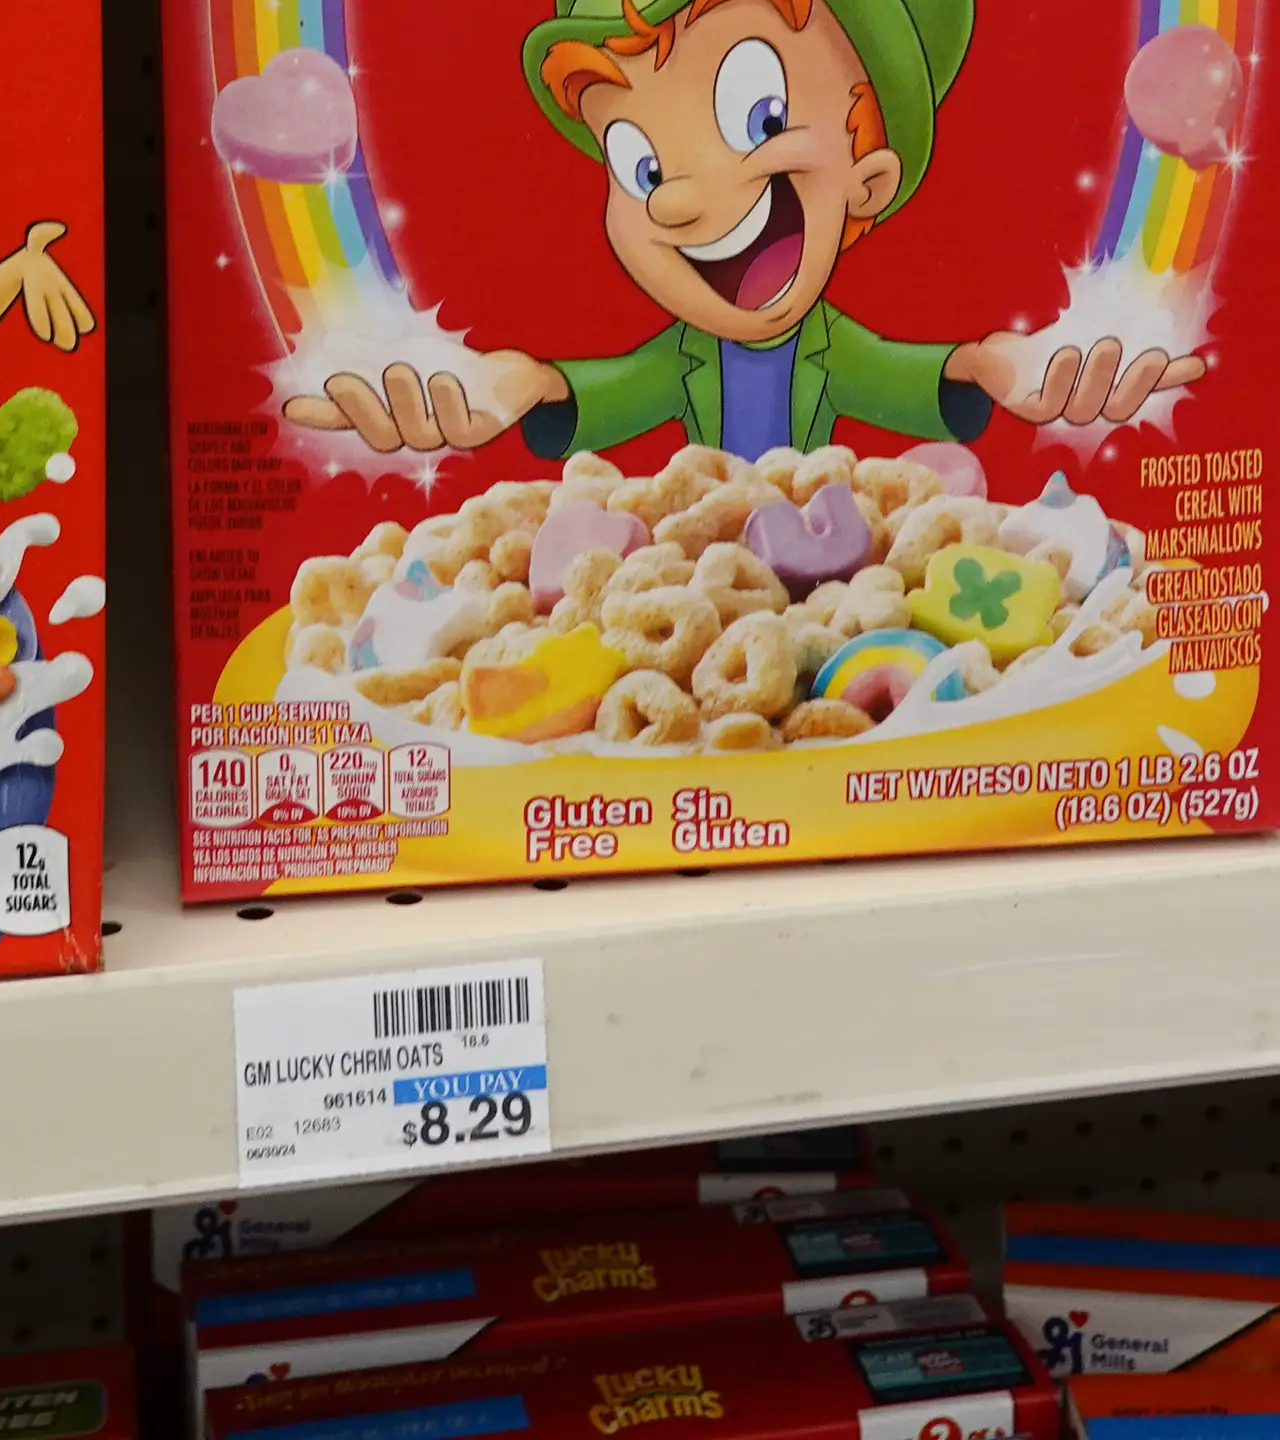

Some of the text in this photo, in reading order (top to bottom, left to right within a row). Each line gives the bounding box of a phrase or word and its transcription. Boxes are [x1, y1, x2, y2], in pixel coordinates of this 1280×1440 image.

[1141, 448, 1262, 488] FROSTED TOASTED
[1175, 484, 1262, 521] CEREAL WITH
[1147, 520, 1262, 560] MARSHMALLOWS
[1147, 563, 1261, 603] CEREAL TOSTADO
[1158, 598, 1261, 638] GLASEADO CON
[1171, 634, 1261, 673] MALVAVISCOS
[847, 748, 1259, 803] NET WT/PESO NETO 1 LB 2.6 OZ
[525, 794, 652, 833] Gluten
[673, 790, 730, 822] Sin
[1055, 787, 1259, 831] (18.6 OZ) (527g)
[527, 829, 617, 861] Free
[673, 818, 788, 852] Gluten
[12, 874, 50, 890] TOTAL
[5, 894, 57, 913] SUGARS
[244, 1042, 443, 1087] GM LUCKY CHRM OATS
[324, 1088, 386, 1110] 961614
[414, 1070, 524, 1100] YOU PAY
[403, 1090, 532, 1149] $8.29
[589, 1390, 725, 1435] Charms
